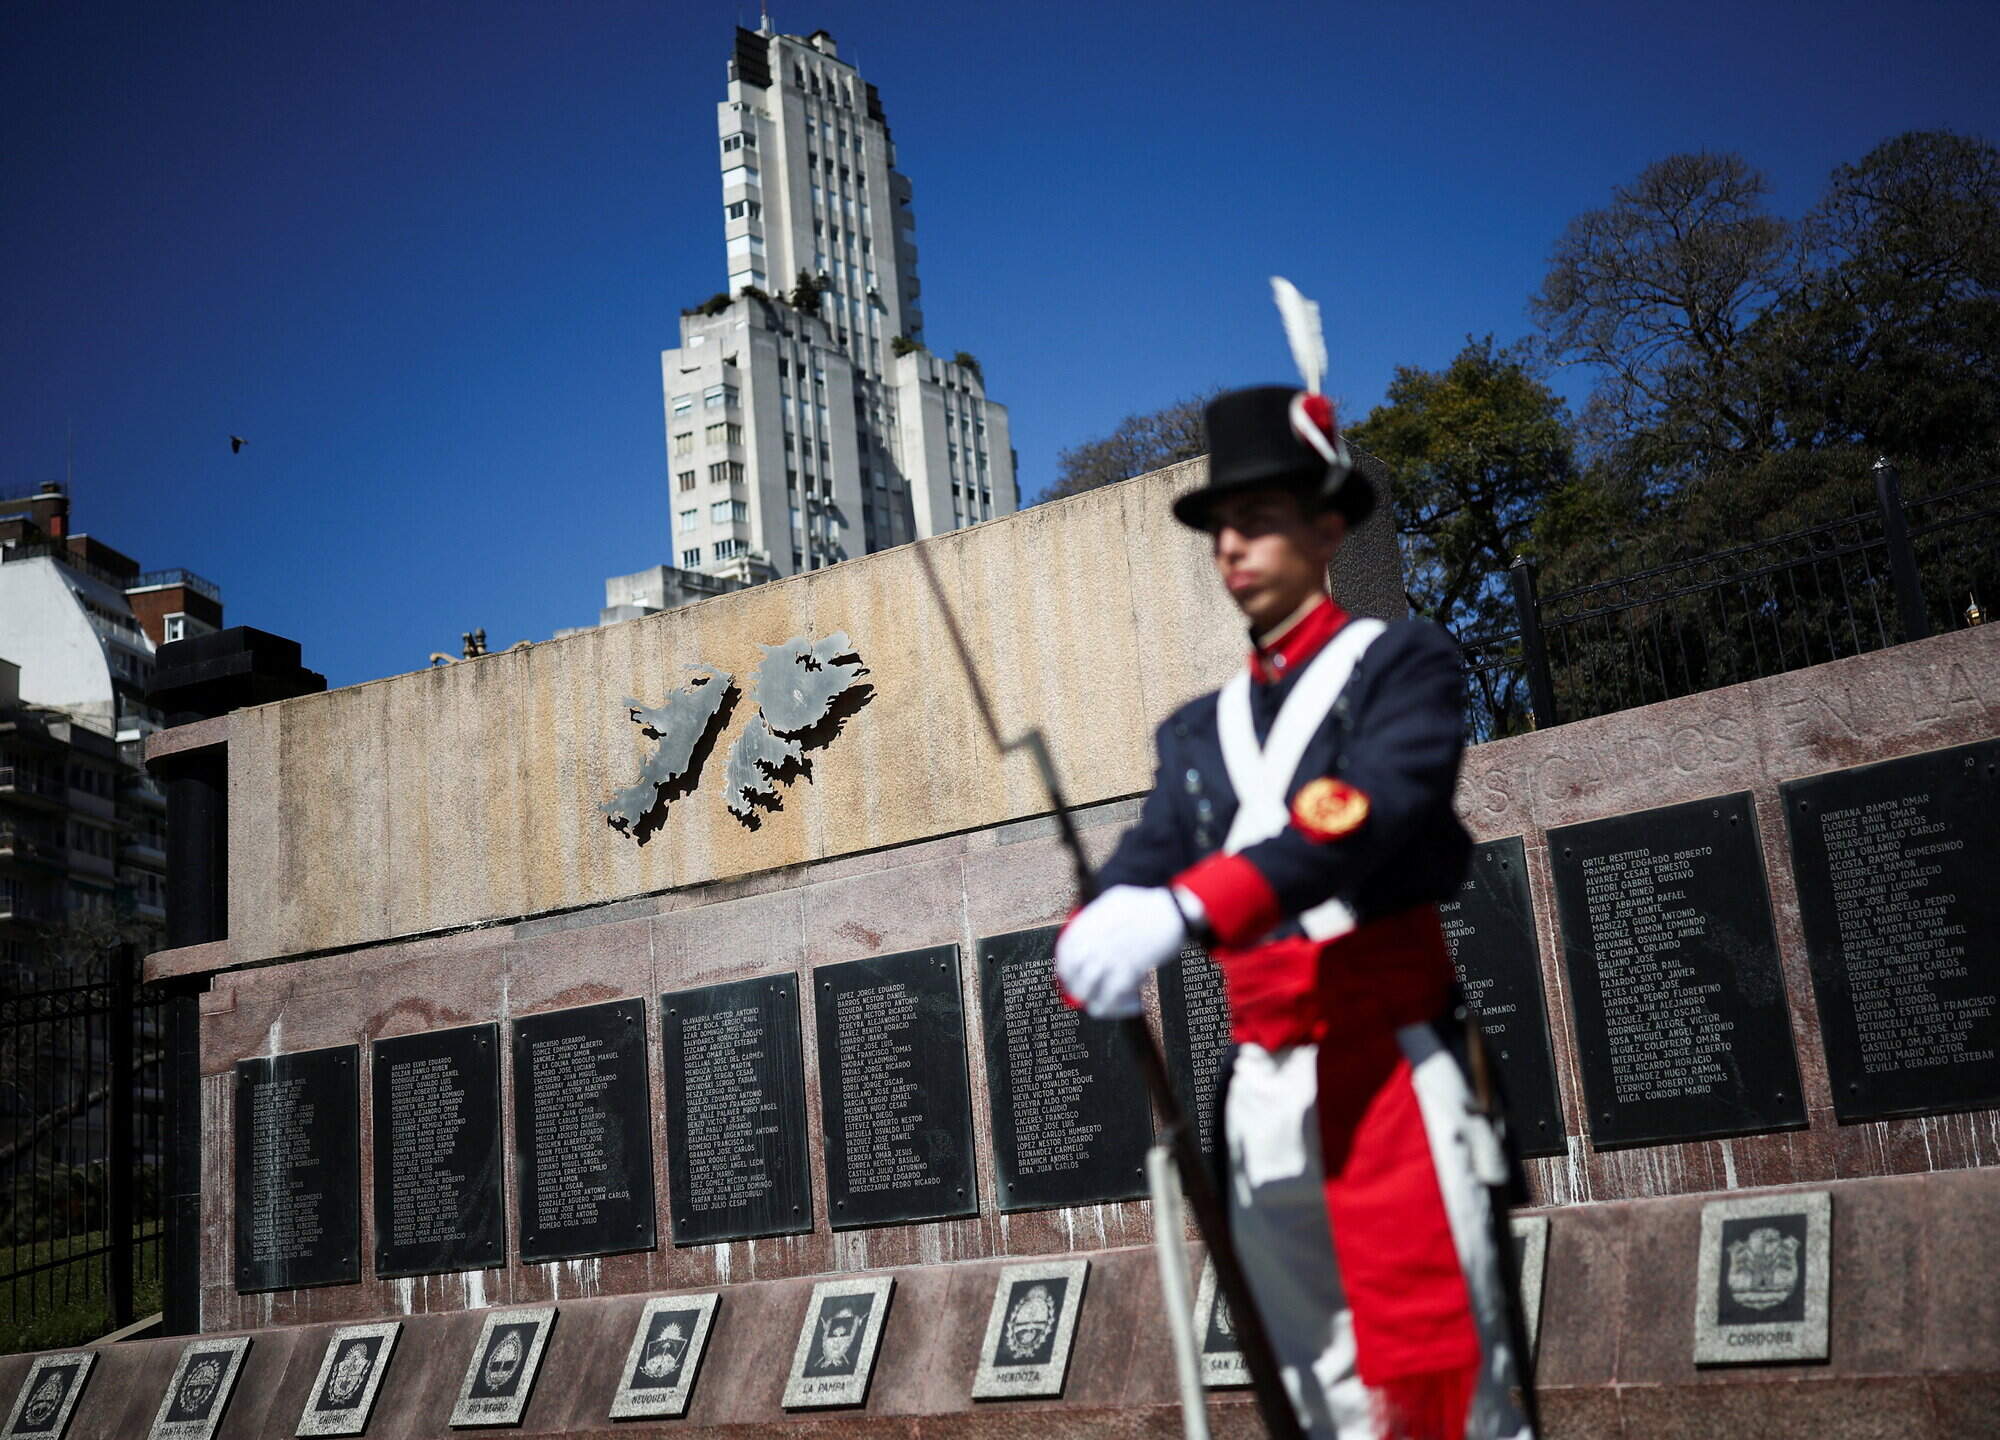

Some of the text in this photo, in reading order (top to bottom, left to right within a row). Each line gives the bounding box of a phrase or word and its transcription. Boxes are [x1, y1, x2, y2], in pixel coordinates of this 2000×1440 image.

[1965, 757, 1974, 767] 10
[1713, 809, 1719, 818] 9
[1821, 794, 1929, 823] QUINTANA RAMON OMAR
[1823, 807, 1917, 832] FLORICE RAUL OMAR
[1583, 848, 1650, 868] ORTIZ RESTITUTO
[1829, 840, 1901, 861] AYLAN ORLANDO
[1831, 840, 1964, 872] ACOSTA RAMON GUMERSINDO
[1585, 846, 1713, 877] PRAMPARO EDGARDO ROBERTO
[1586, 860, 1690, 886] ALVAREZ CESAR ERNESTO
[1587, 869, 1694, 895] FATTORI GABRIEL GUSTAVO
[1834, 865, 1942, 891] SUELDO ATILIO IDALECIO
[1588, 886, 1655, 905] MENDOZA IRINEO
[1590, 890, 1686, 914] RIVAS ABRAHAM RAFAEL
[1839, 894, 1956, 921] LOTUFO MARCELO PEDRO
[1593, 908, 1696, 933] MARIZZA GUIDO ANTONIO
[1841, 906, 1947, 931] FROLA MARIO ESTEBAN
[1844, 924, 1966, 952] GRAMISCI DONATO MANUEL
[1597, 939, 1681, 961] DE CHIARA ORLANDO
[1598, 953, 1655, 970] GALIANO JOSE
[1849, 957, 1959, 982] CORDOBA JUAN CARLOS
[1601, 967, 1696, 989] FAJARDO SIXTO JAVIER
[837, 984, 905, 1000] LOPEZ JORGE EDUARDO
[1604, 982, 1721, 1008] LARROSA PEDRO FLORENTINO
[1853, 983, 1928, 1002] BARRIOS RAFAEL
[1607, 1005, 1701, 1027] VAZQUEZ JULIO OSCAR
[1608, 1012, 1720, 1037] RODRIGUEZ ALEGRE VICTOR
[840, 1045, 860, 1053] GOMEZ
[864, 1042, 878, 1050] JOSE
[1862, 1031, 1968, 1053] CASTILLO OMAR JESUS
[842, 1061, 911, 1076] FARIAS JORGE RICARDO
[1011, 1062, 1062, 1076] GOMEZ EDUARDO
[1614, 1053, 1712, 1075] RUIZ RICARDO HORACIO
[1011, 1067, 1079, 1084] CHAILE OMAR ANDRES
[844, 1093, 911, 1107] GARCIA SERGIO ISMAEL
[1013, 1093, 1080, 1109] PEREYRA ALDO OMAR
[845, 1111, 893, 1122] FERREYRA DIEGO
[1015, 1110, 1079, 1125] CACERES FRANCISCO
[846, 1129, 872, 1138] BRIZUELA
[875, 1126, 900, 1135] OSVALDO
[1017, 1124, 1102, 1142] VANEGA CARLOS HUMBERTO
[847, 1143, 890, 1154] BENITEZ ANGEL
[996, 1370, 1041, 1383] MENDOZA
[802, 1383, 814, 1394] LA
